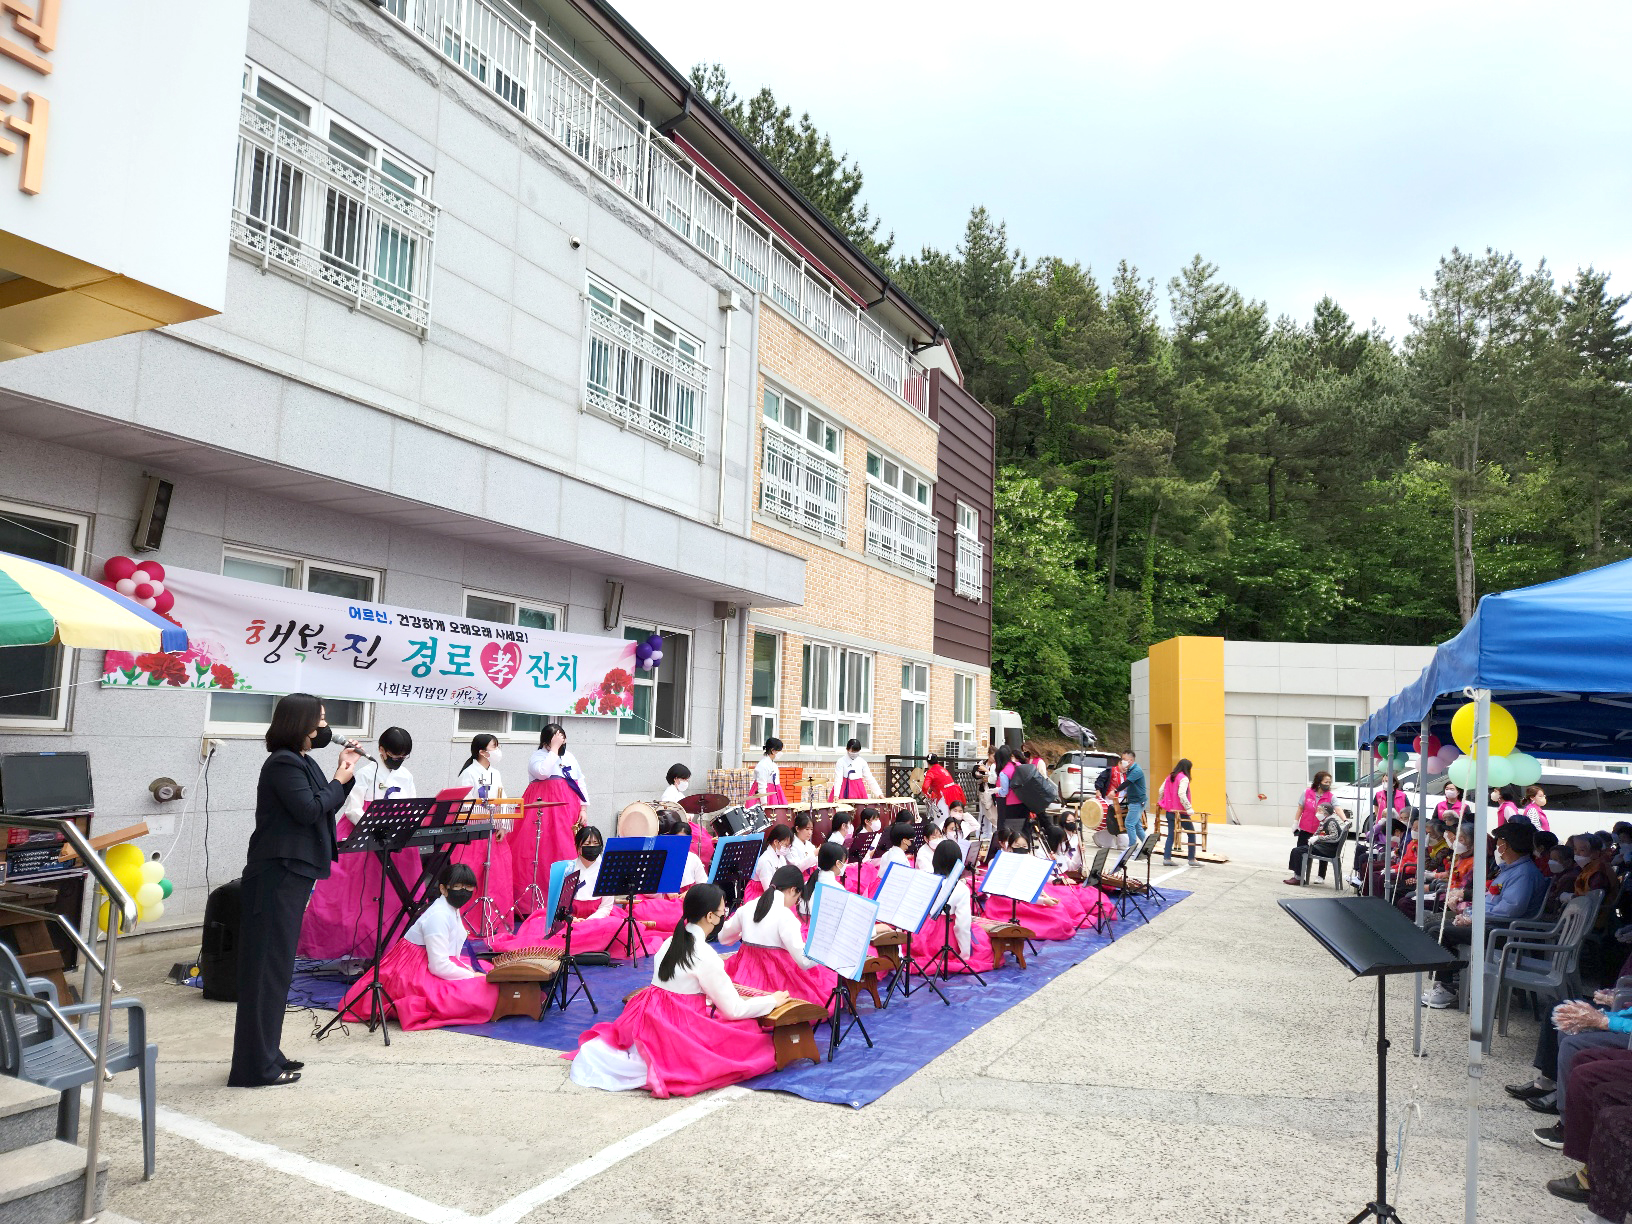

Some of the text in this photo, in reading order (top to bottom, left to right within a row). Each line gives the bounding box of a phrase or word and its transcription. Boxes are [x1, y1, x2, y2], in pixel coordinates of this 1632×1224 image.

[348, 606, 529, 643] 어르신, 건강하게 오래오래 사세요!
[401, 636, 475, 679] 경로
[487, 649, 515, 685] 孝
[525, 651, 578, 693] 잔치
[376, 681, 448, 701] 사회복지법인
